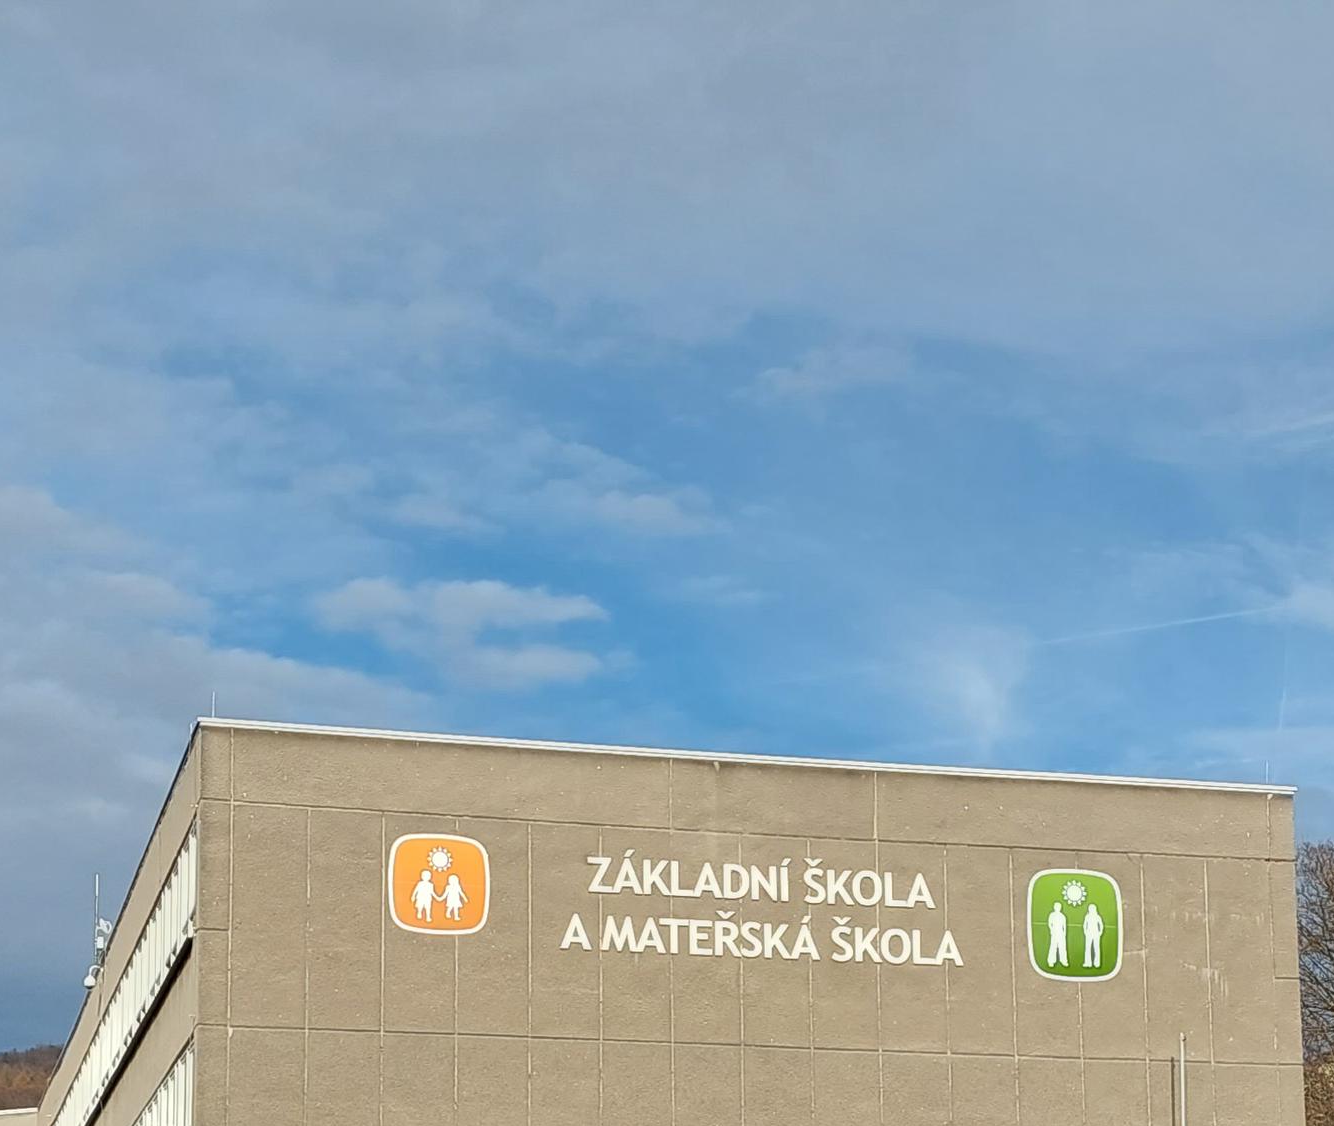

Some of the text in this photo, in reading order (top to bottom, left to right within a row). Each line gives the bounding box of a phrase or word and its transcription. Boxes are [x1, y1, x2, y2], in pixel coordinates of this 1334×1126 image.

[587, 849, 936, 909] ZÁKLADNÍ ŠKOLA
[561, 910, 964, 967] A MATEŘSKÁ ŠKOLA
